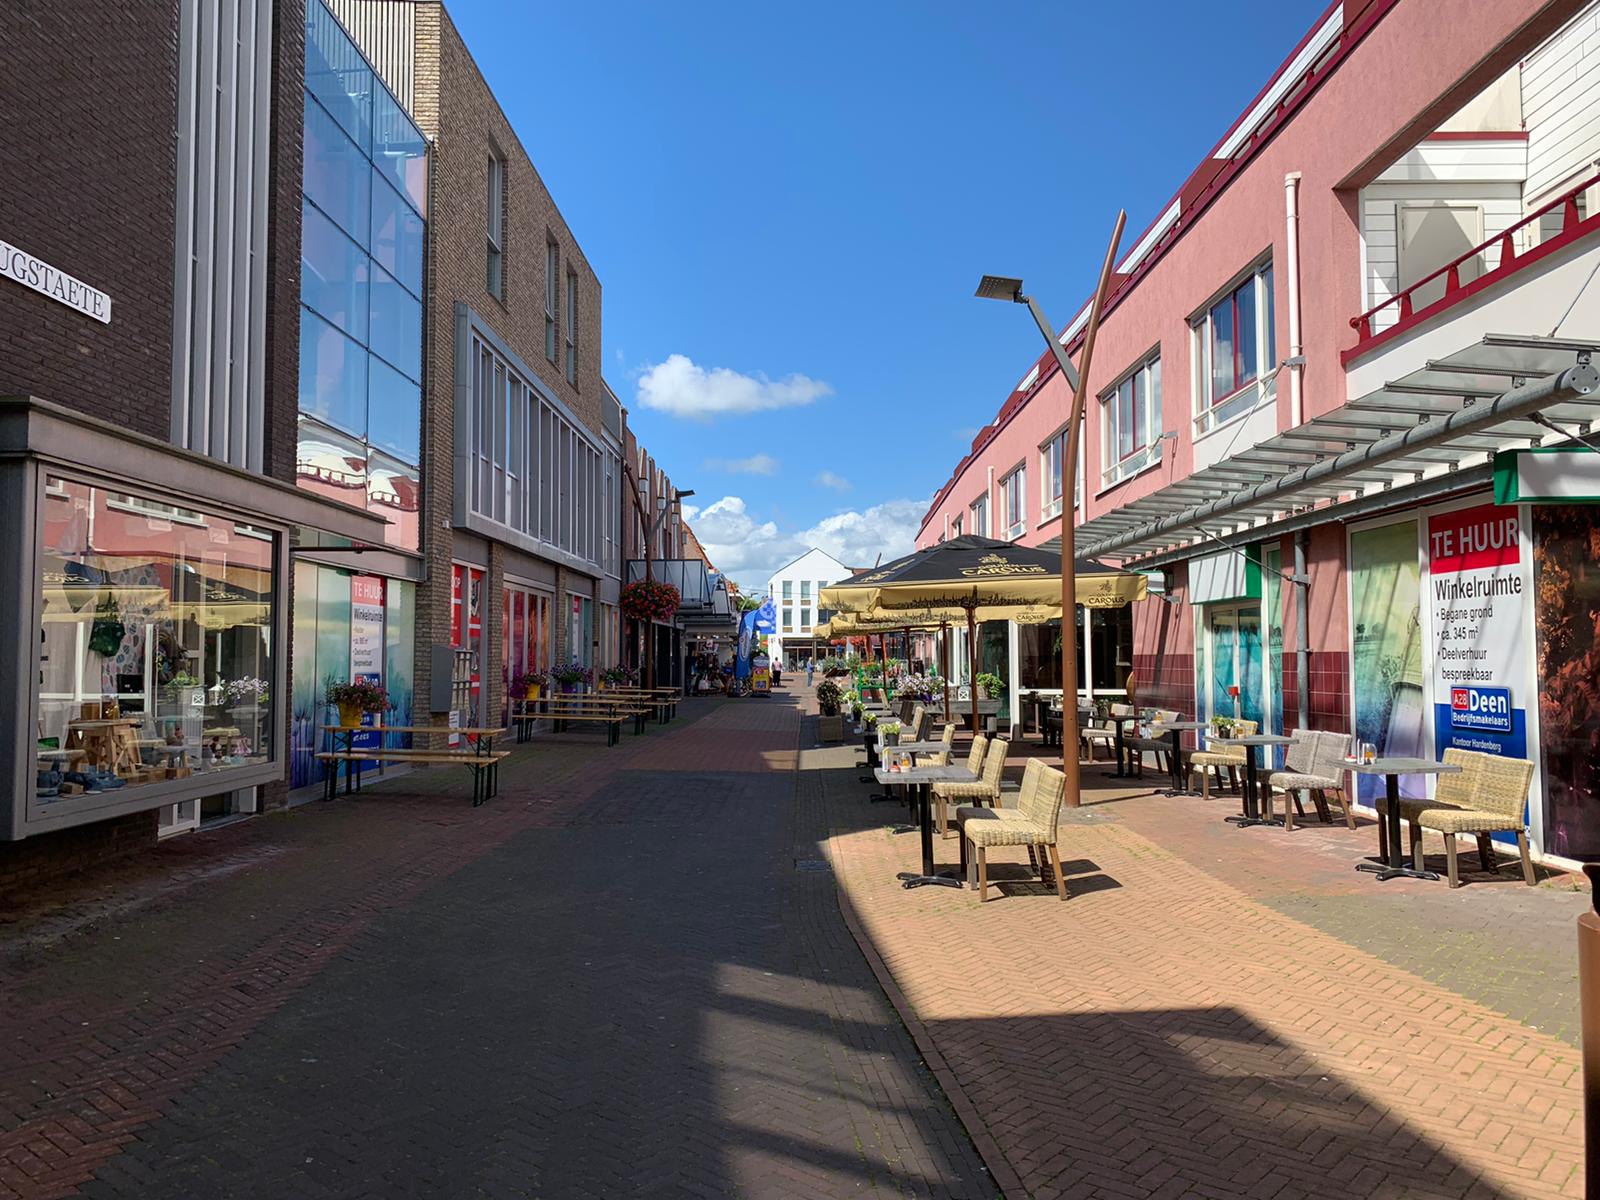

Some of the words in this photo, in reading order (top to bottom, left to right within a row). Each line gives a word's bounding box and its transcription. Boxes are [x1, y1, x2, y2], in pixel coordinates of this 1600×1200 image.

[1431, 530, 1454, 558] TE
[1459, 517, 1520, 554] HUUR
[961, 566, 1047, 577] CAROLUS
[353, 582, 362, 597] TE
[363, 583, 384, 601] HUUR
[1435, 572, 1522, 601] Winkelruimte
[1088, 596, 1125, 607] CAROLUS
[1440, 608, 1468, 624] Begane
[1470, 604, 1493, 622] grond
[1441, 630, 1452, 640] ca.
[1454, 626, 1467, 640] 345
[1441, 647, 1488, 660] Deelverhuur
[1441, 667, 1493, 682] bespreekbaar
[1469, 689, 1507, 713] Deen
[1453, 712, 1508, 726] Bedrijfsmakelaars
[1452, 736, 1471, 747] Kantoor
[1472, 738, 1502, 753] Hardenberg
